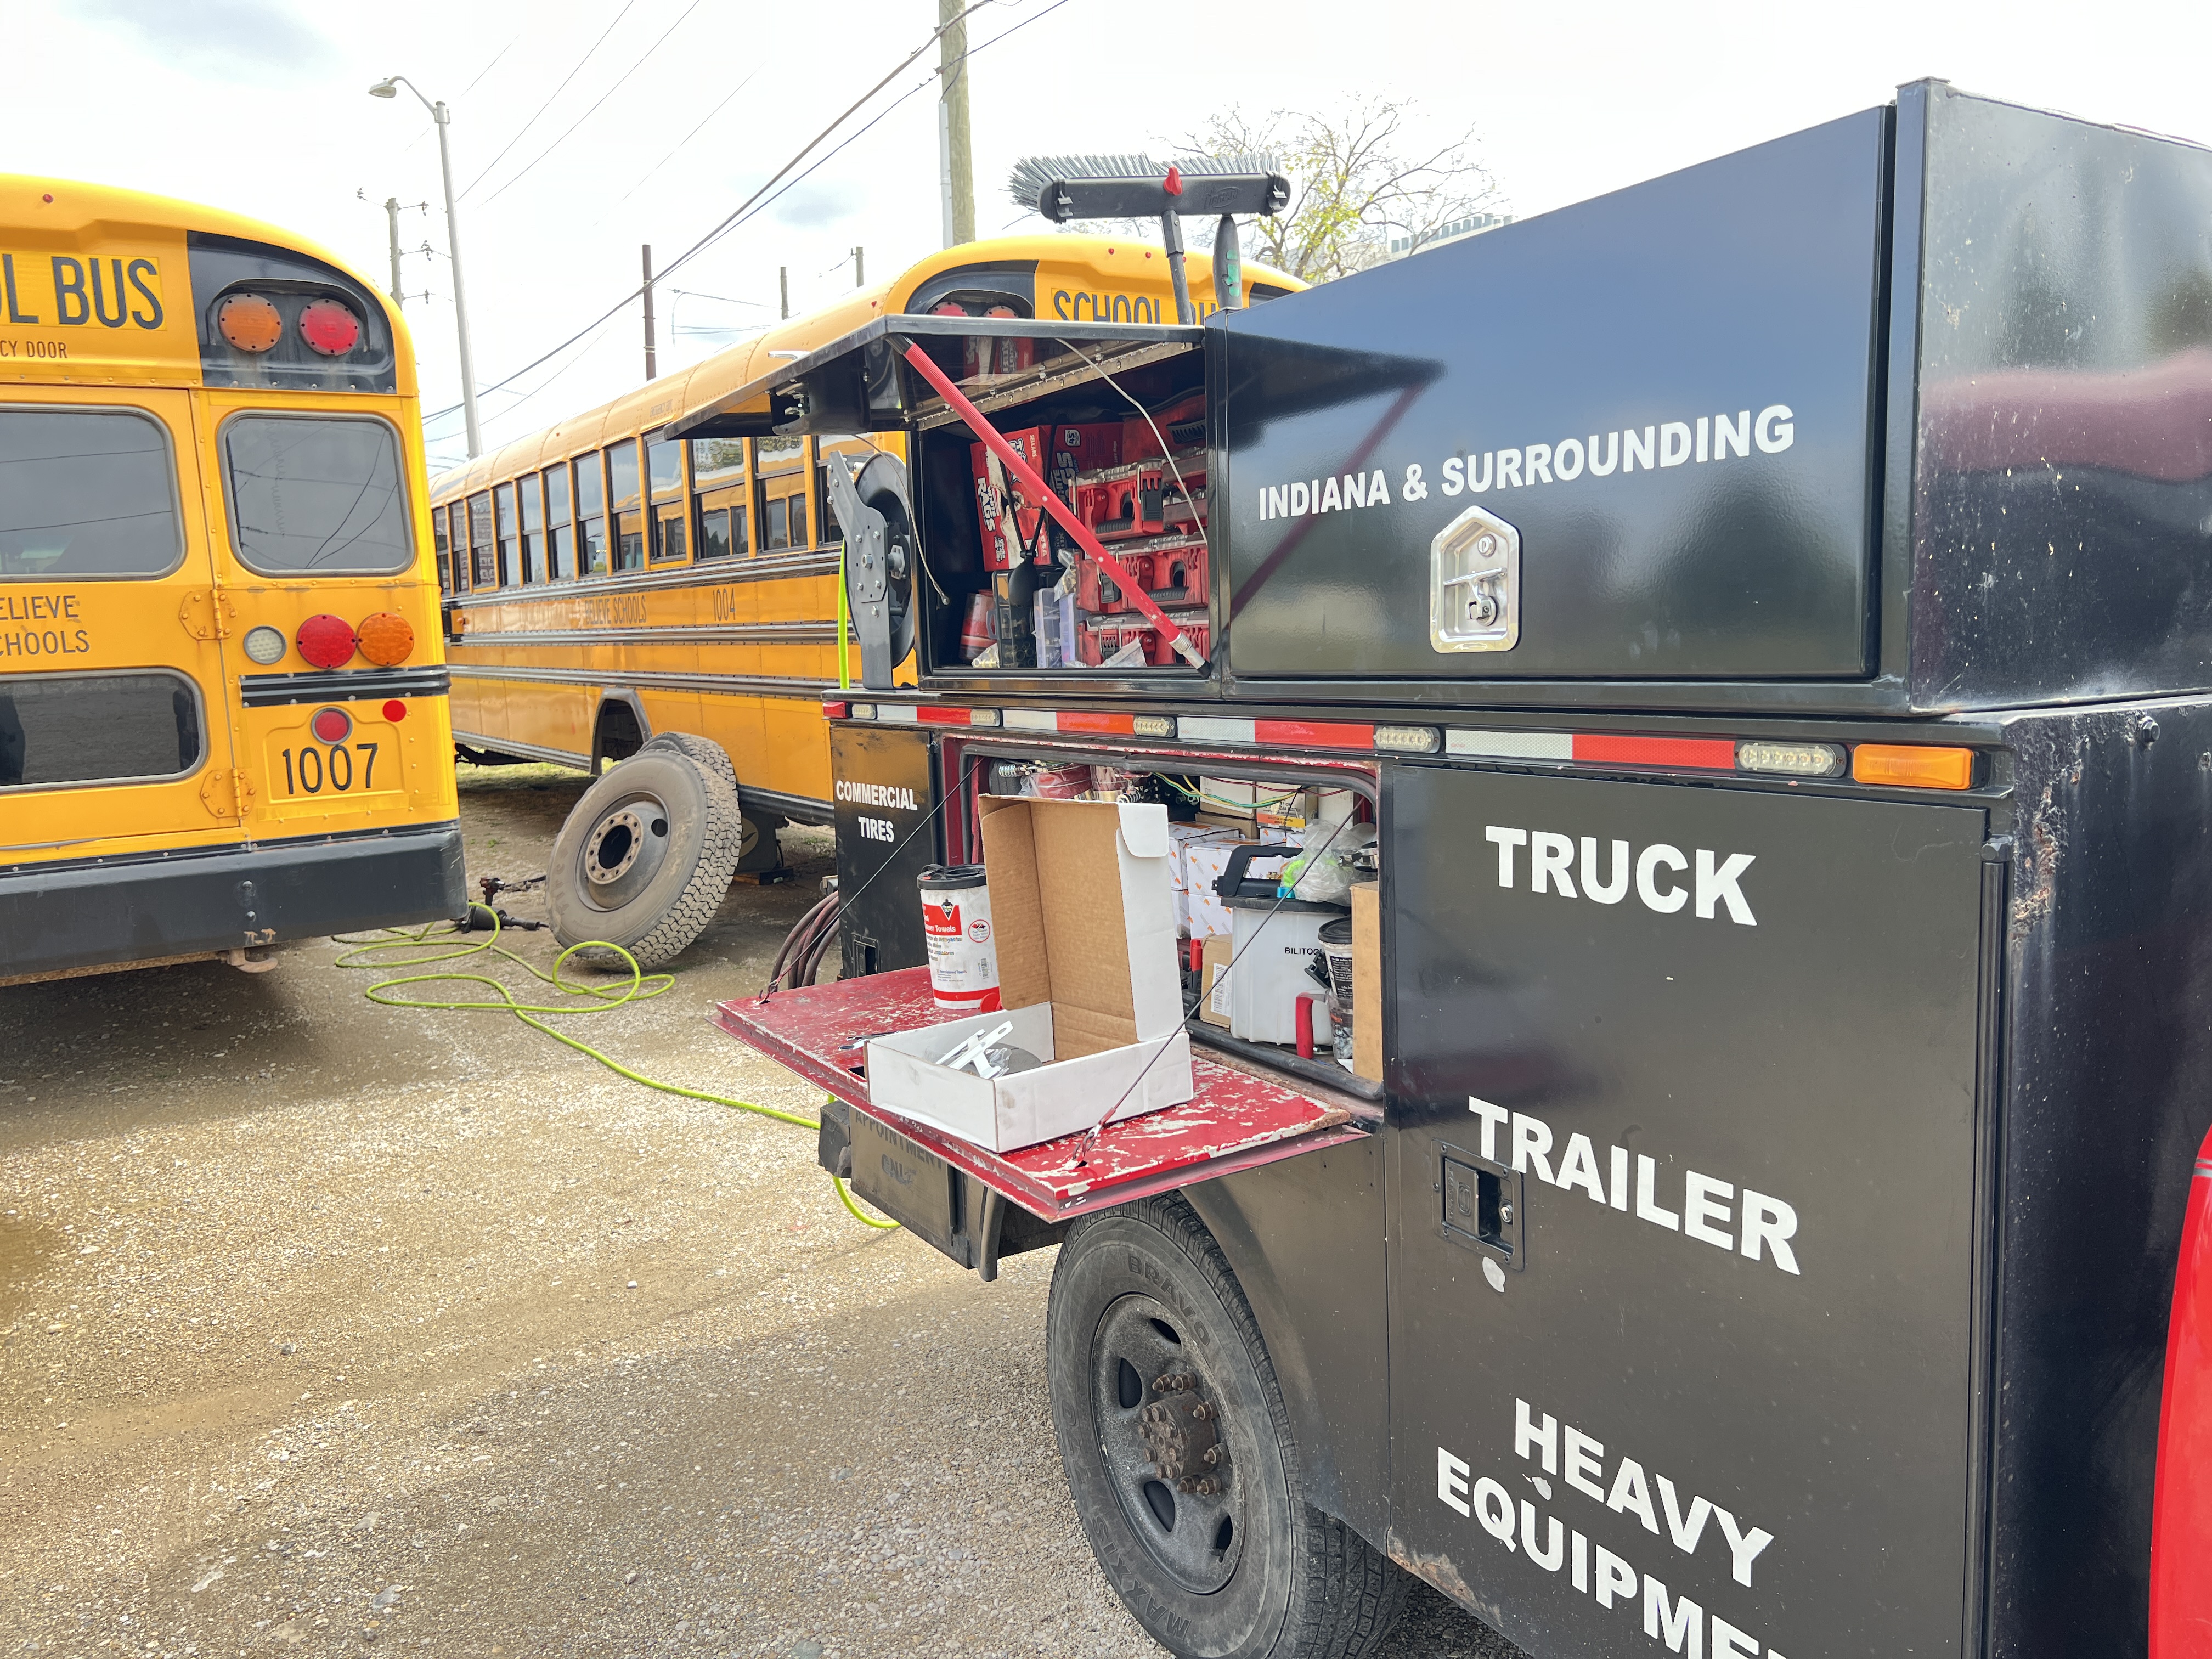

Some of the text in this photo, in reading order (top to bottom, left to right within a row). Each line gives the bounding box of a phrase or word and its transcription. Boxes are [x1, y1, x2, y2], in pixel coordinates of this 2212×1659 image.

[51, 256, 163, 330] BUS
[26, 341, 68, 359] DOOR
[1029, 434, 1037, 458] SELLARS
[1068, 432, 1075, 444] 45
[1259, 404, 1795, 521] INDIANA & SURROUNDING
[977, 477, 996, 532] RAGS
[584, 595, 648, 625] BELIEVE SCHOOLS
[713, 586, 736, 622] 1004
[0, 630, 89, 656] HOOLS
[282, 743, 379, 795] 1007
[836, 780, 918, 811] COMMERCIAL
[857, 816, 894, 843] TIRES
[1485, 825, 1757, 926] TRUCK
[935, 924, 956, 933] Towels
[1468, 1096, 1801, 1276] TRAILER
[1127, 1254, 1210, 1347] BRAVO
[1514, 1397, 1775, 1588] HEAVY
[1092, 1515, 1192, 1641] MAXXIS
[1437, 1446, 1787, 1659] EQUIPME
